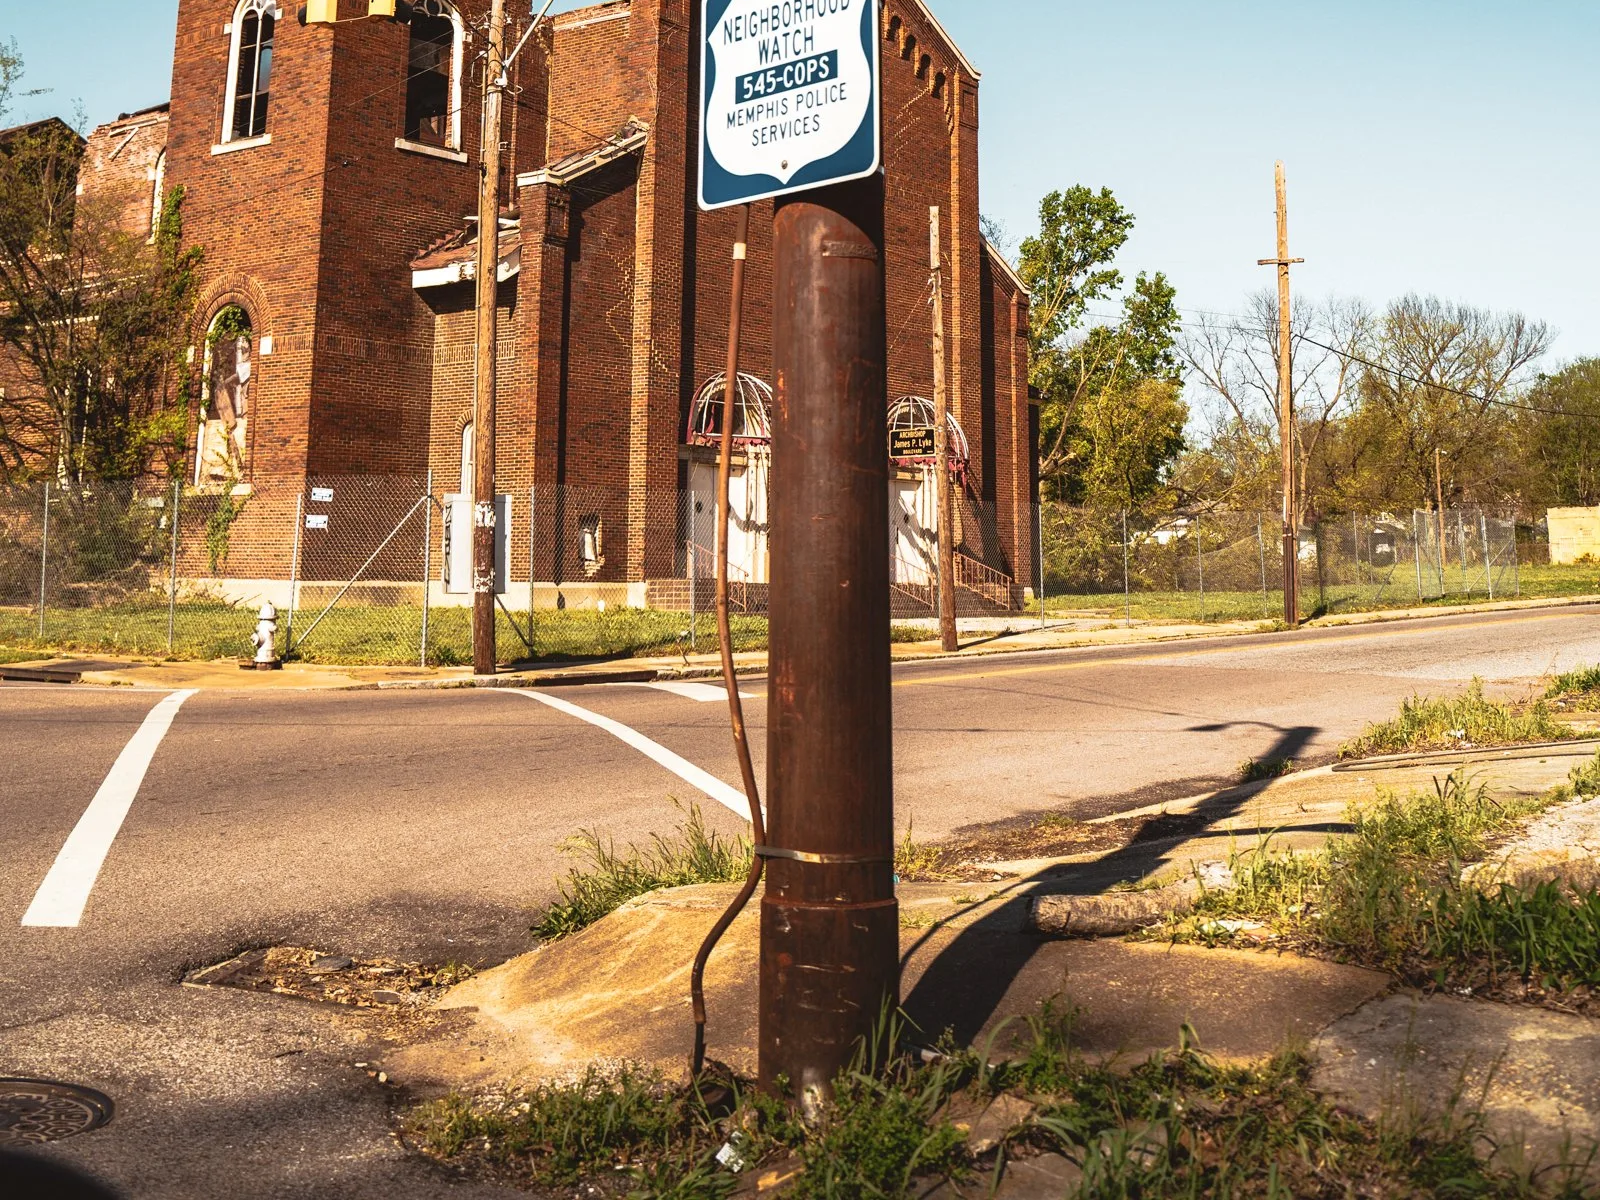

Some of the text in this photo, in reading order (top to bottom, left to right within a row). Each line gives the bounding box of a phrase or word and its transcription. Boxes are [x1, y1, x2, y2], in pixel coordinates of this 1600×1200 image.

[758, 25, 814, 66] WATCH
[743, 55, 830, 99] 545-COPS
[727, 82, 847, 129] MEMPHIS POLICE
[751, 113, 820, 147] SERVICES
[893, 438, 932, 449] James P. Lyke
[899, 430, 926, 439] ARCHBISHOP
